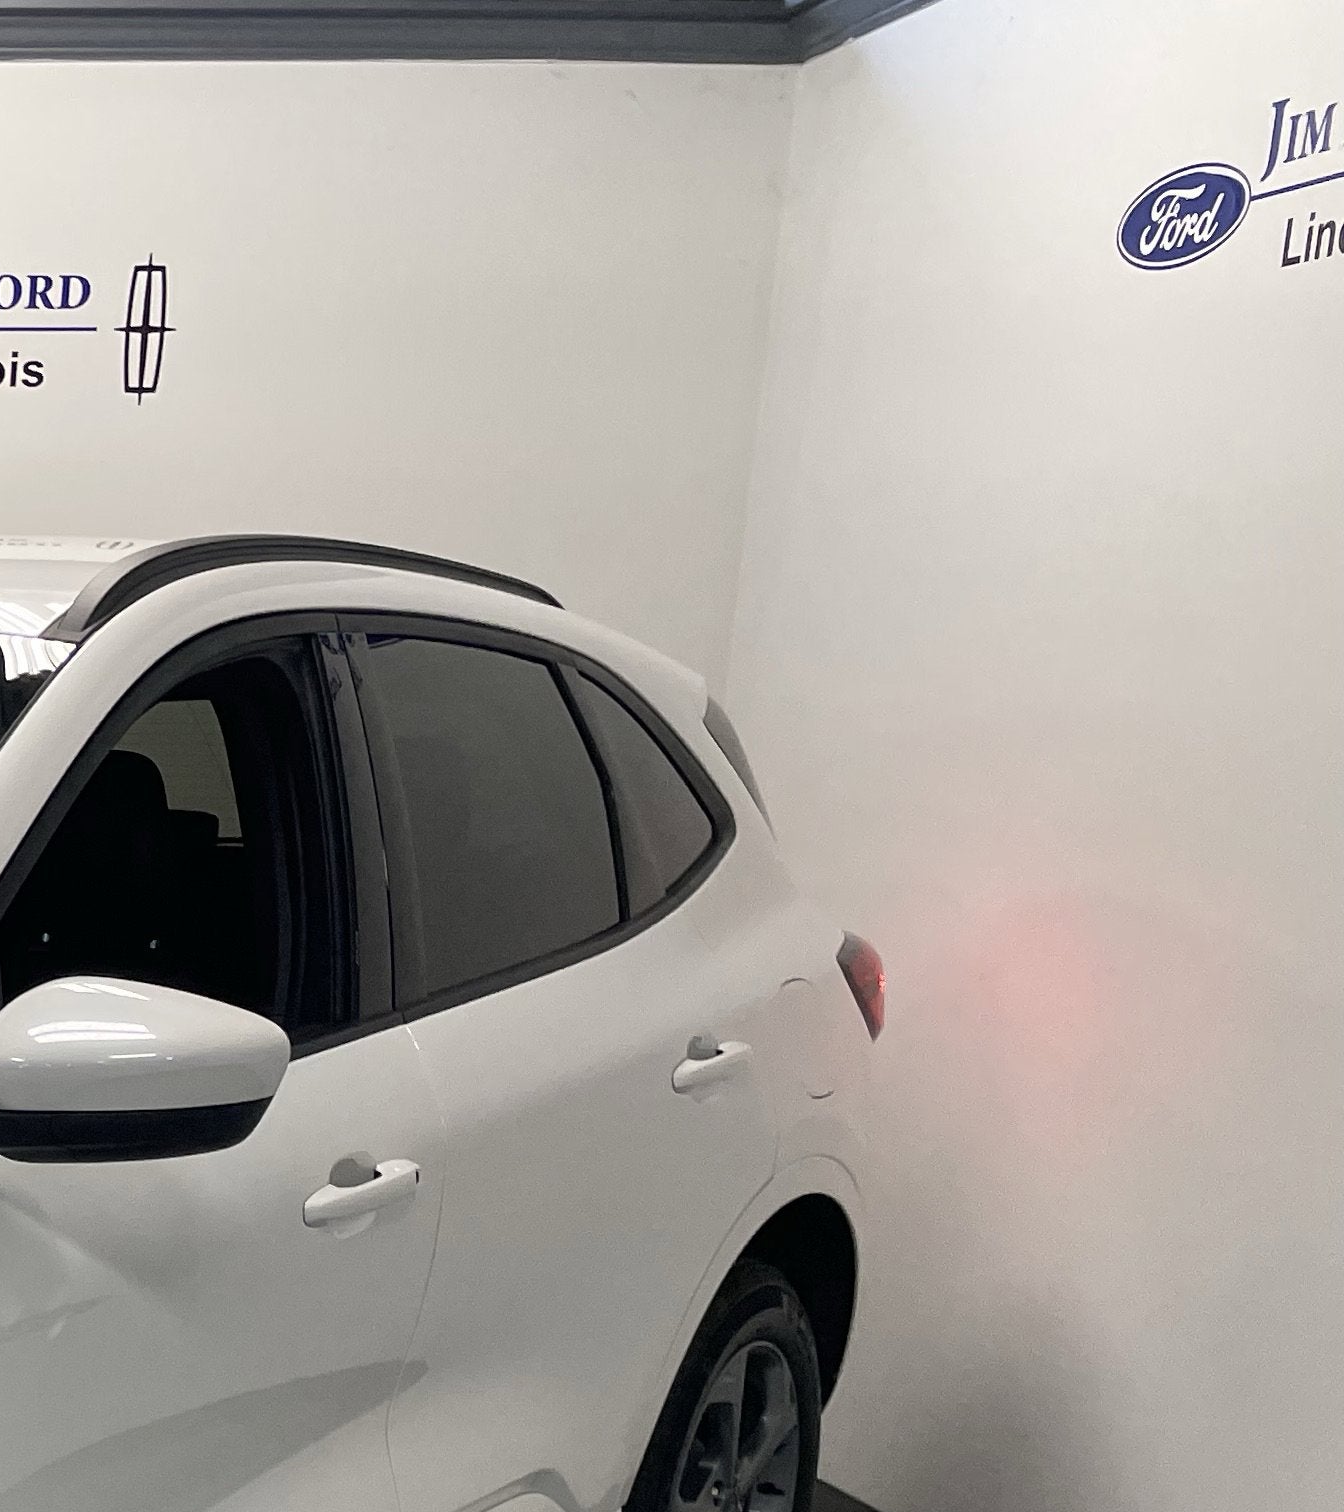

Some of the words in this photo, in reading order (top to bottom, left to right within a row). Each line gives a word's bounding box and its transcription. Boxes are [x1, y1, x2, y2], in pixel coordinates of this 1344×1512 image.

[1260, 97, 1338, 182] JIM
[1139, 183, 1225, 256] Ford
[1281, 211, 1344, 268] Lin
